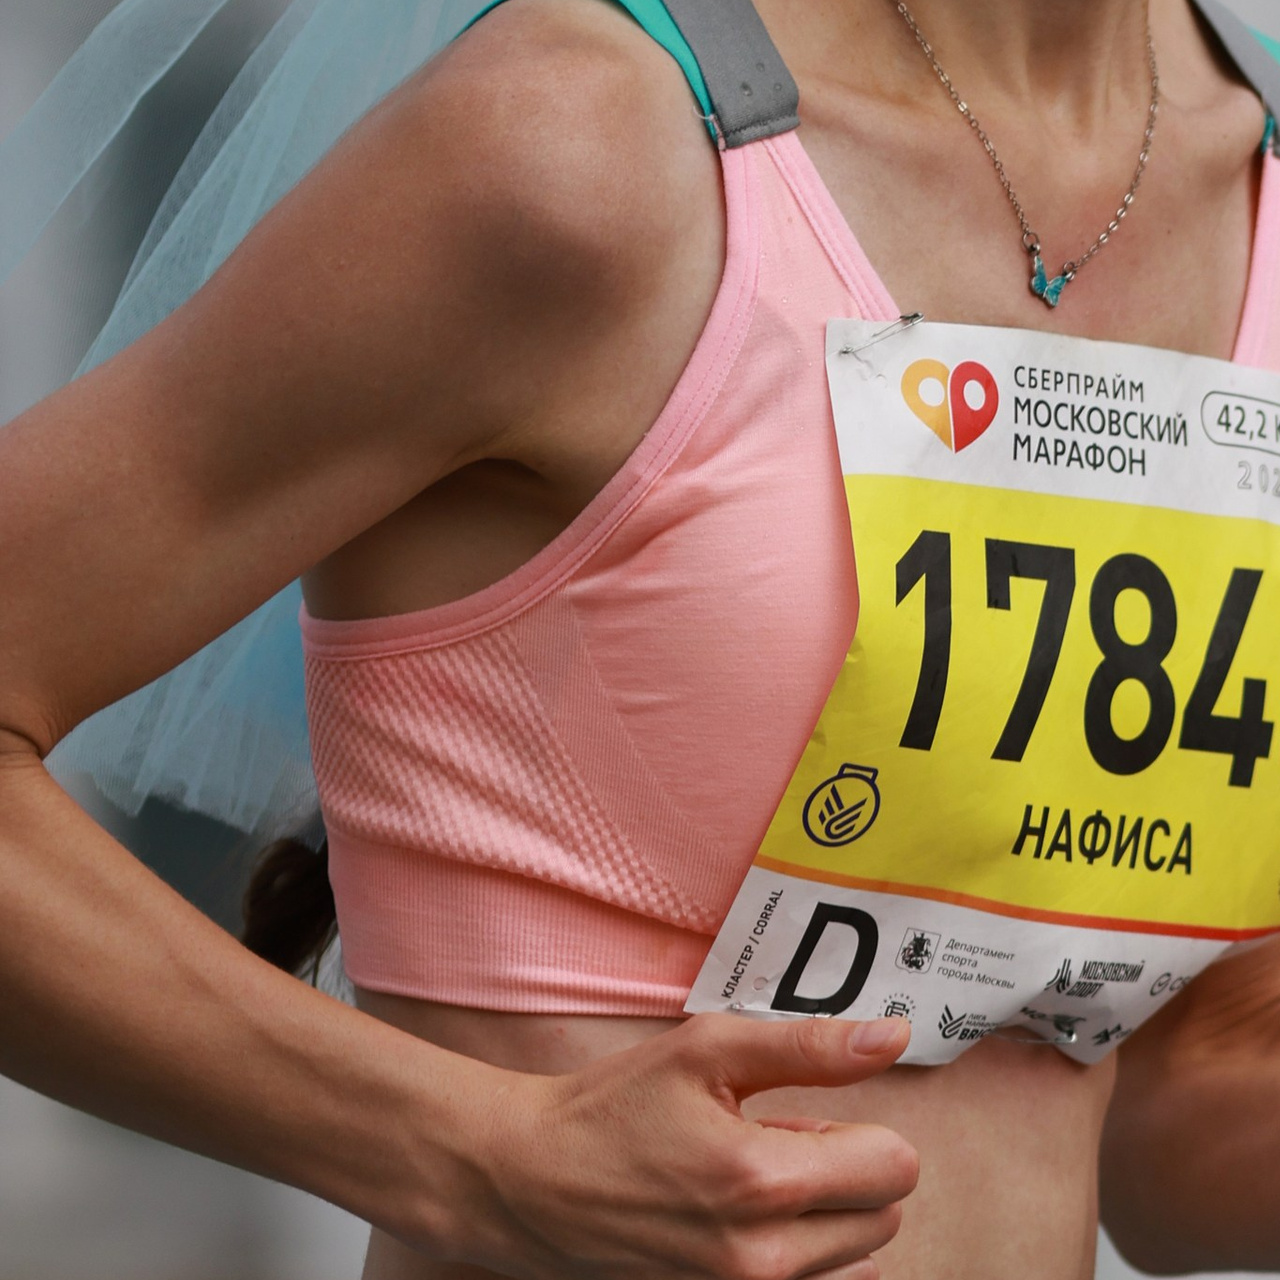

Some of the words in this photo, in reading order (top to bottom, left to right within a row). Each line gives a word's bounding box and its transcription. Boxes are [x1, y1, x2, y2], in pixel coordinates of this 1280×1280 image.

[1013, 365, 1144, 403] СБЕРПРАЙМ
[1014, 397, 1188, 447] МОСКОВСКИЙ
[1217, 404, 1268, 440] 42,2
[1012, 433, 1146, 476] МАРАФОН
[1011, 804, 1193, 875] НАФИСА
[721, 944, 755, 999] КЛАСТЕР
[753, 888, 784, 936] CORRAL
[770, 901, 879, 1017] D
[942, 953, 978, 968] спорта
[945, 938, 1016, 961] Департамент
[937, 966, 974, 981] города
[975, 973, 1016, 989] Москвы
[1079, 959, 1146, 983] МОСКОВСКИЙ
[1066, 982, 1104, 998] СПОРТ
